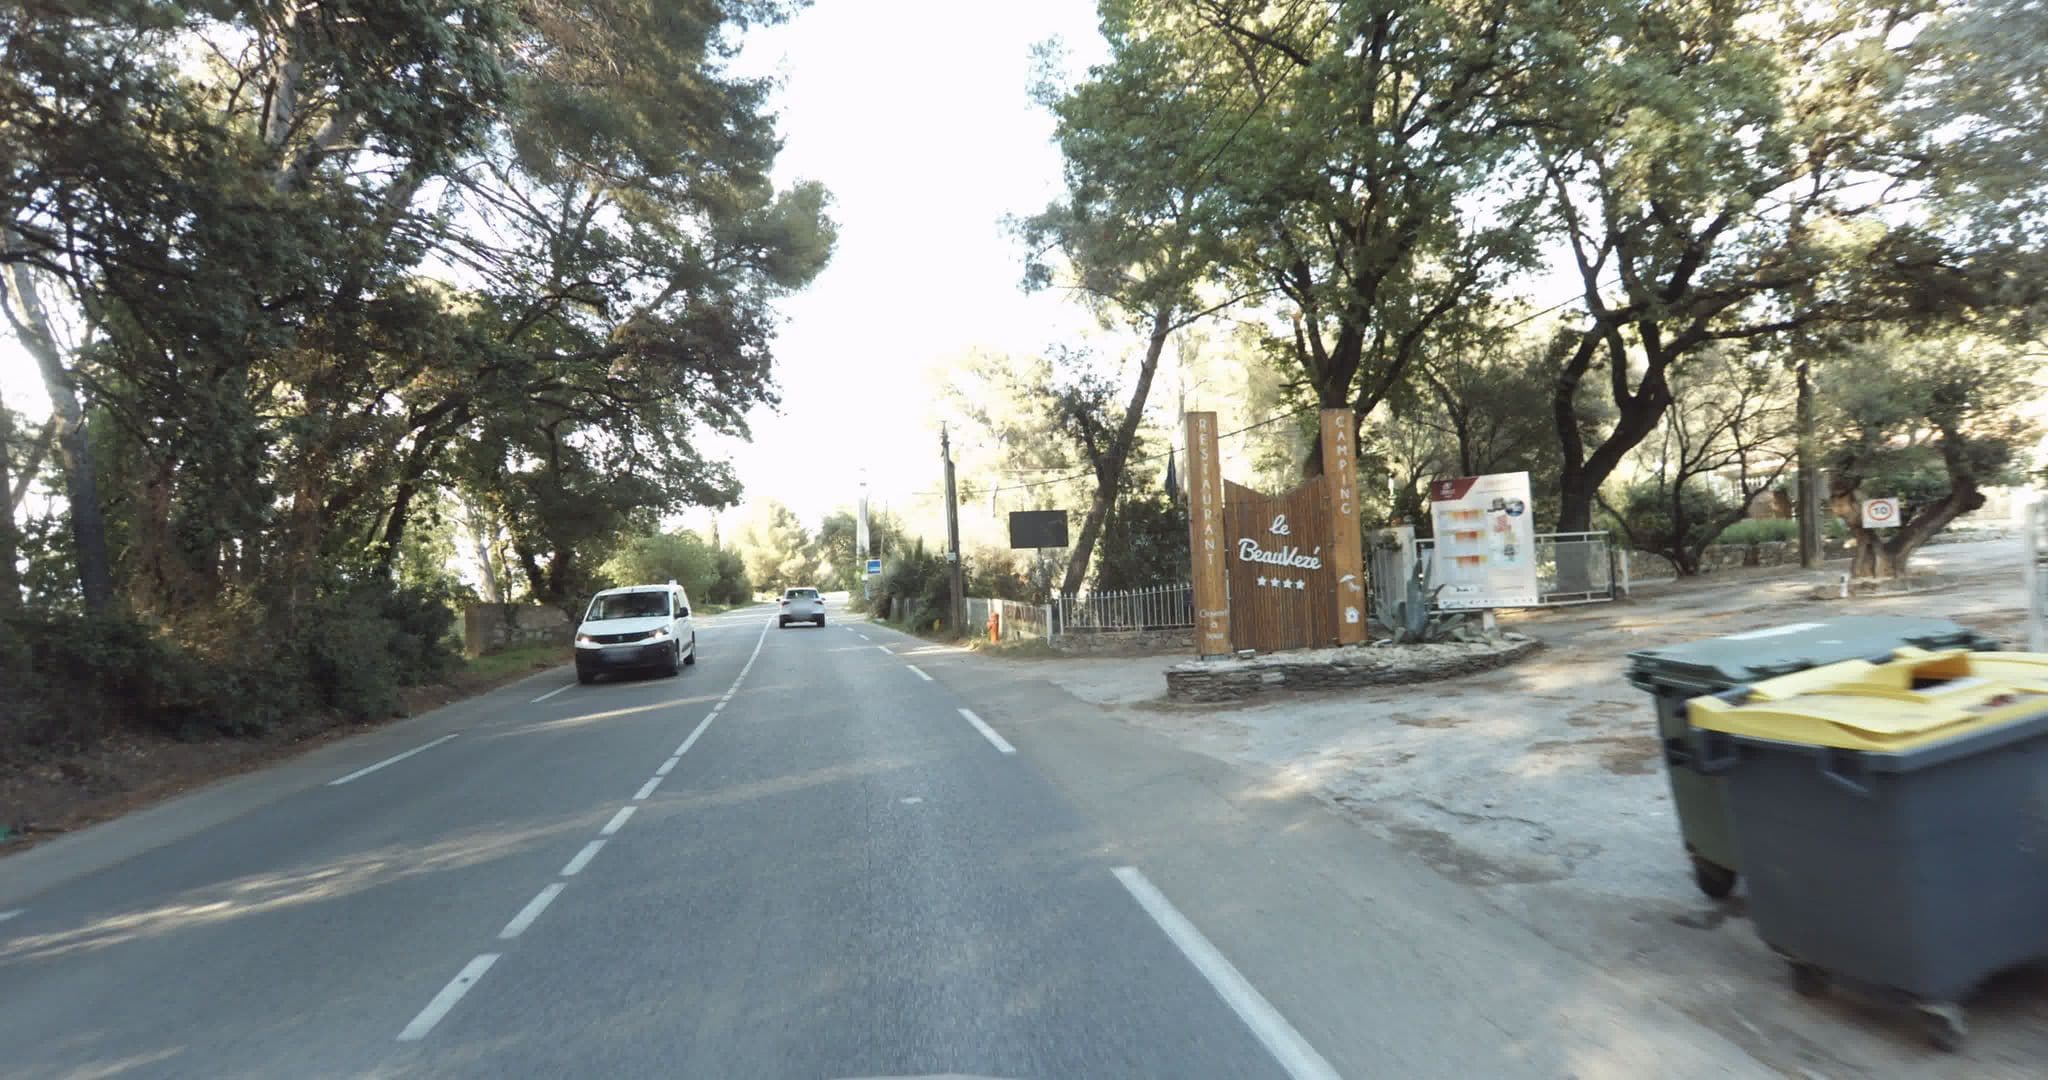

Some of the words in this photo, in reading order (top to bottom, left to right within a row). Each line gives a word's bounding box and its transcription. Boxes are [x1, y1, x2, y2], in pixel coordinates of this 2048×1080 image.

[1199, 418, 1215, 565] RESTAURANT
[1335, 415, 1351, 514] CAMPING
[1238, 538, 1321, 570] BeauVezé
